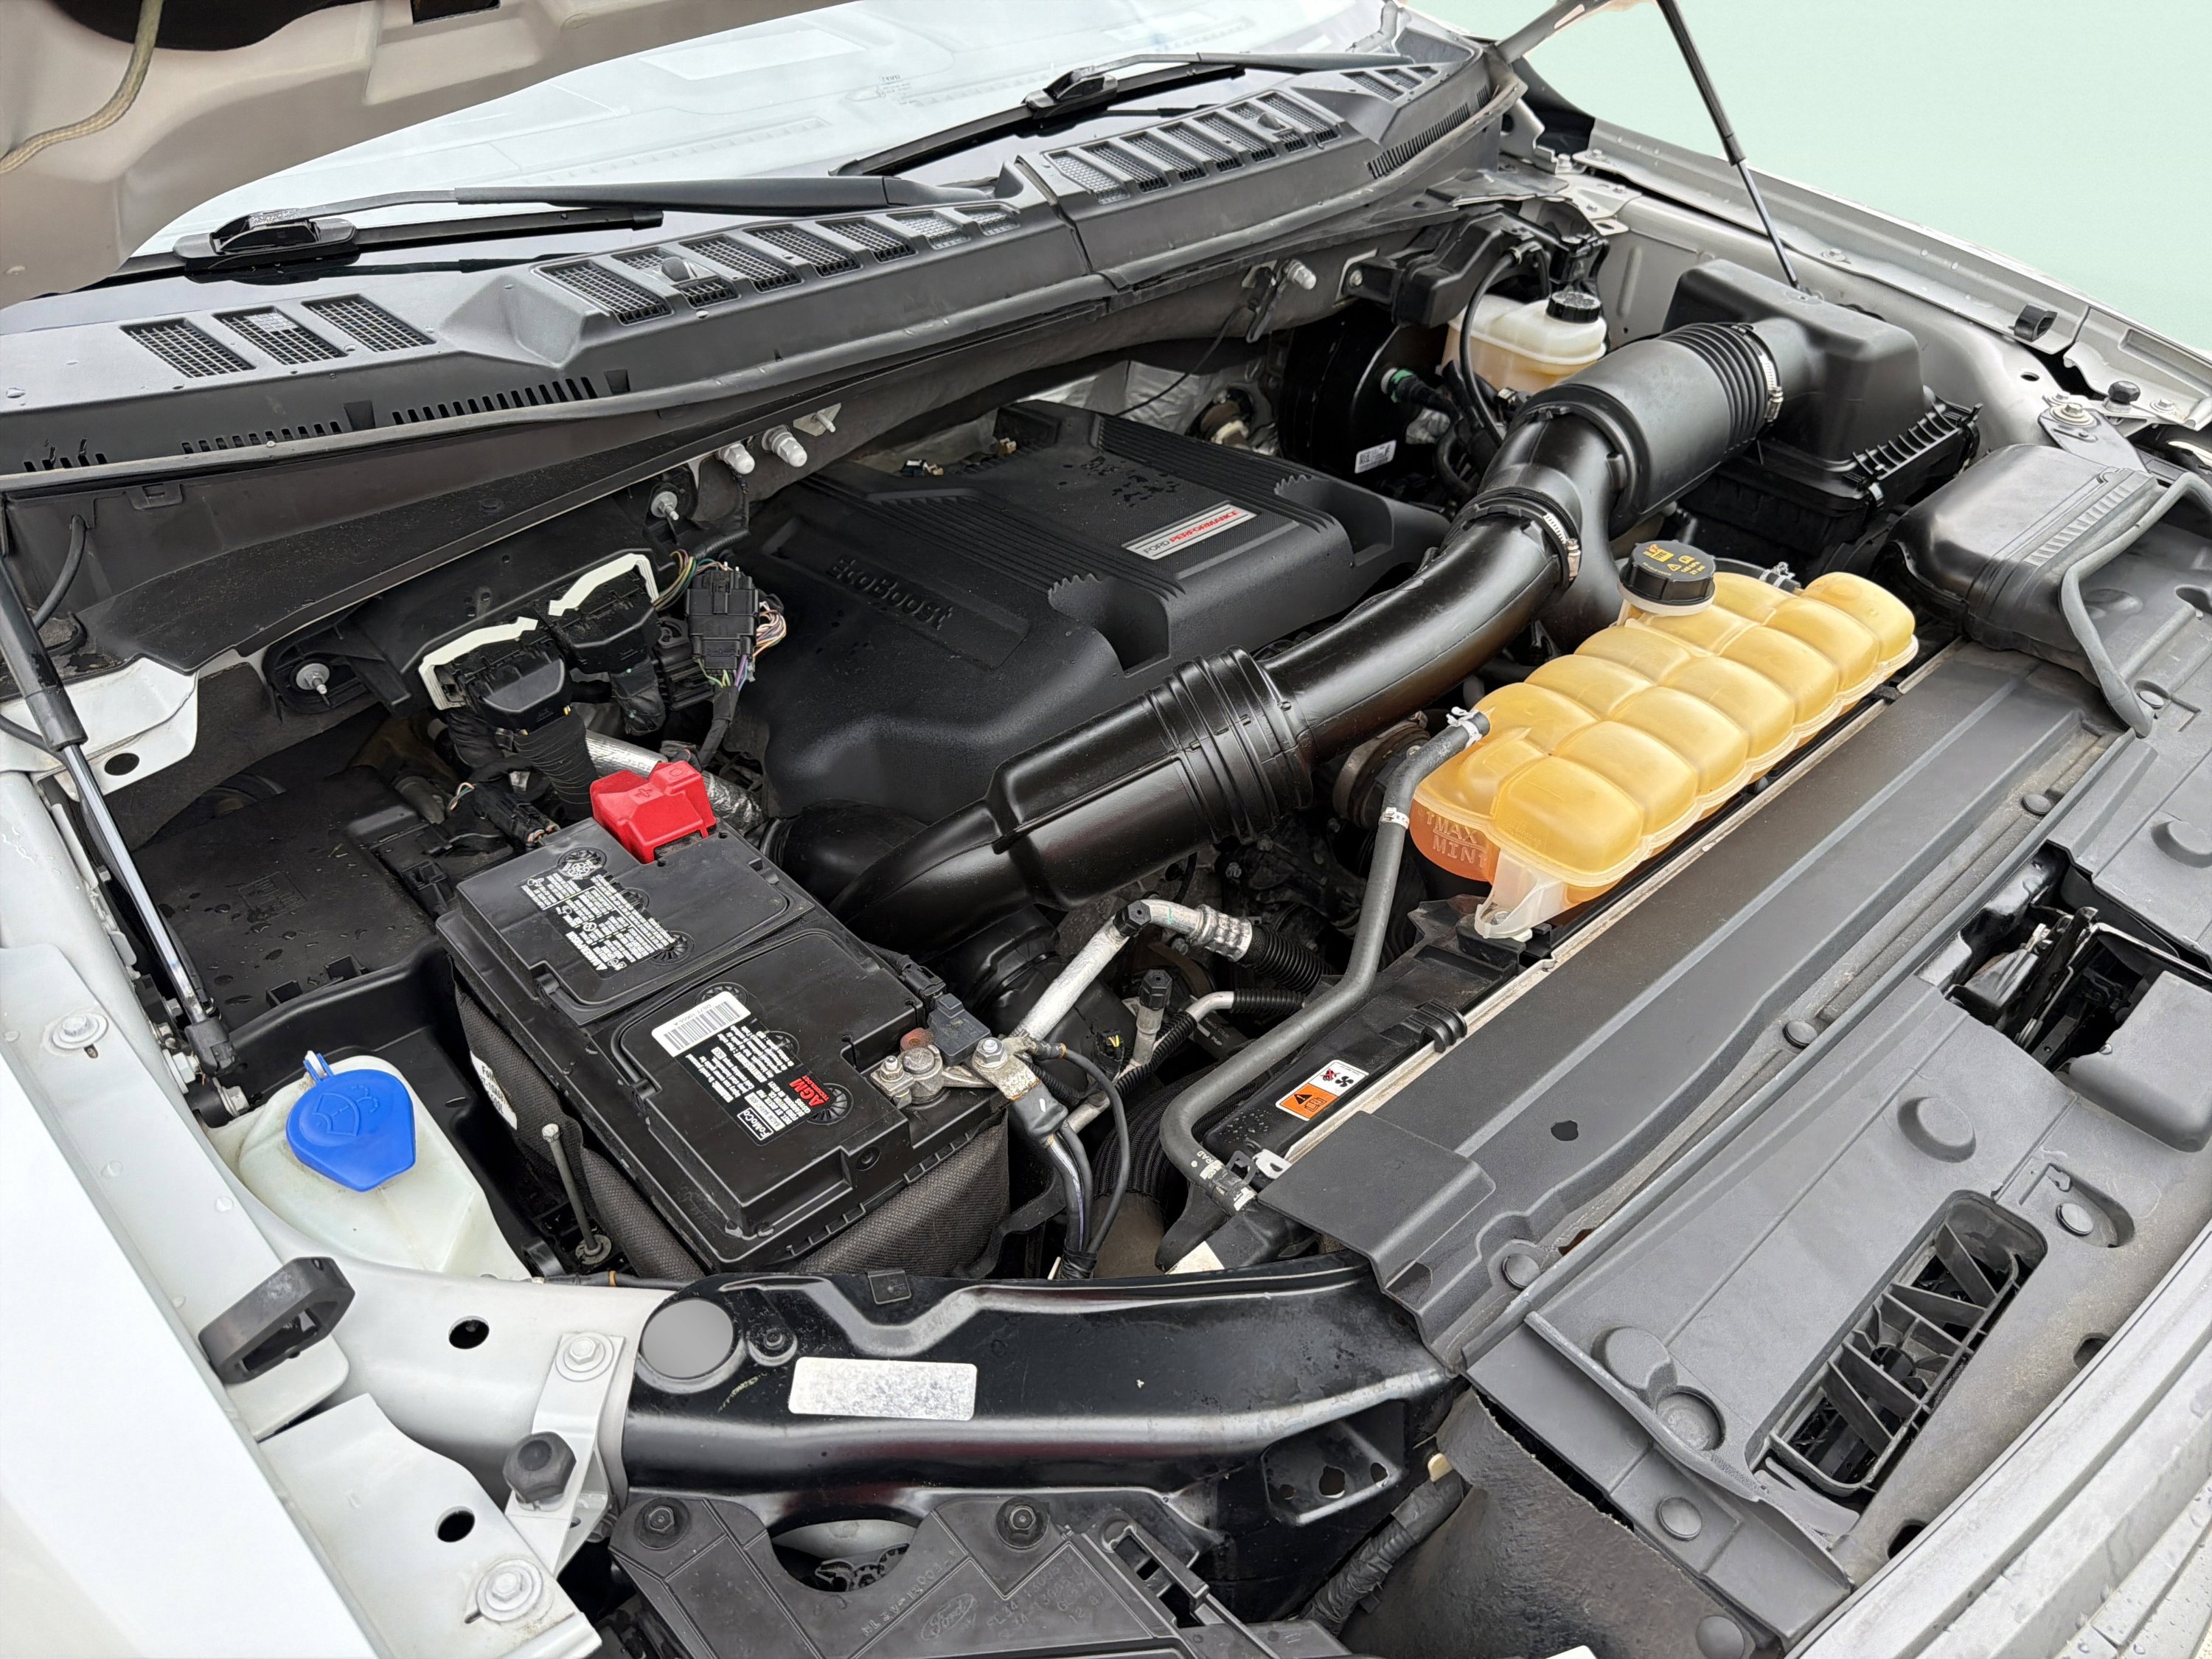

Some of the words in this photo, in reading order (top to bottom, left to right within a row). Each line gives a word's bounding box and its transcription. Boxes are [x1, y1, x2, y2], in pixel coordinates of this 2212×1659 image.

[1144, 540, 1170, 554] FORD
[1169, 509, 1239, 543] PERFORMANCE
[825, 558, 954, 631] EcoBoost
[1434, 815, 1477, 844] MAX
[1433, 835, 1475, 864] MIN
[790, 1079, 824, 1106] AGM
[802, 1075, 829, 1101] TECHNOLOGY
[743, 1110, 771, 1138] FoMoCo
[1196, 1150, 1213, 1164] RAD
